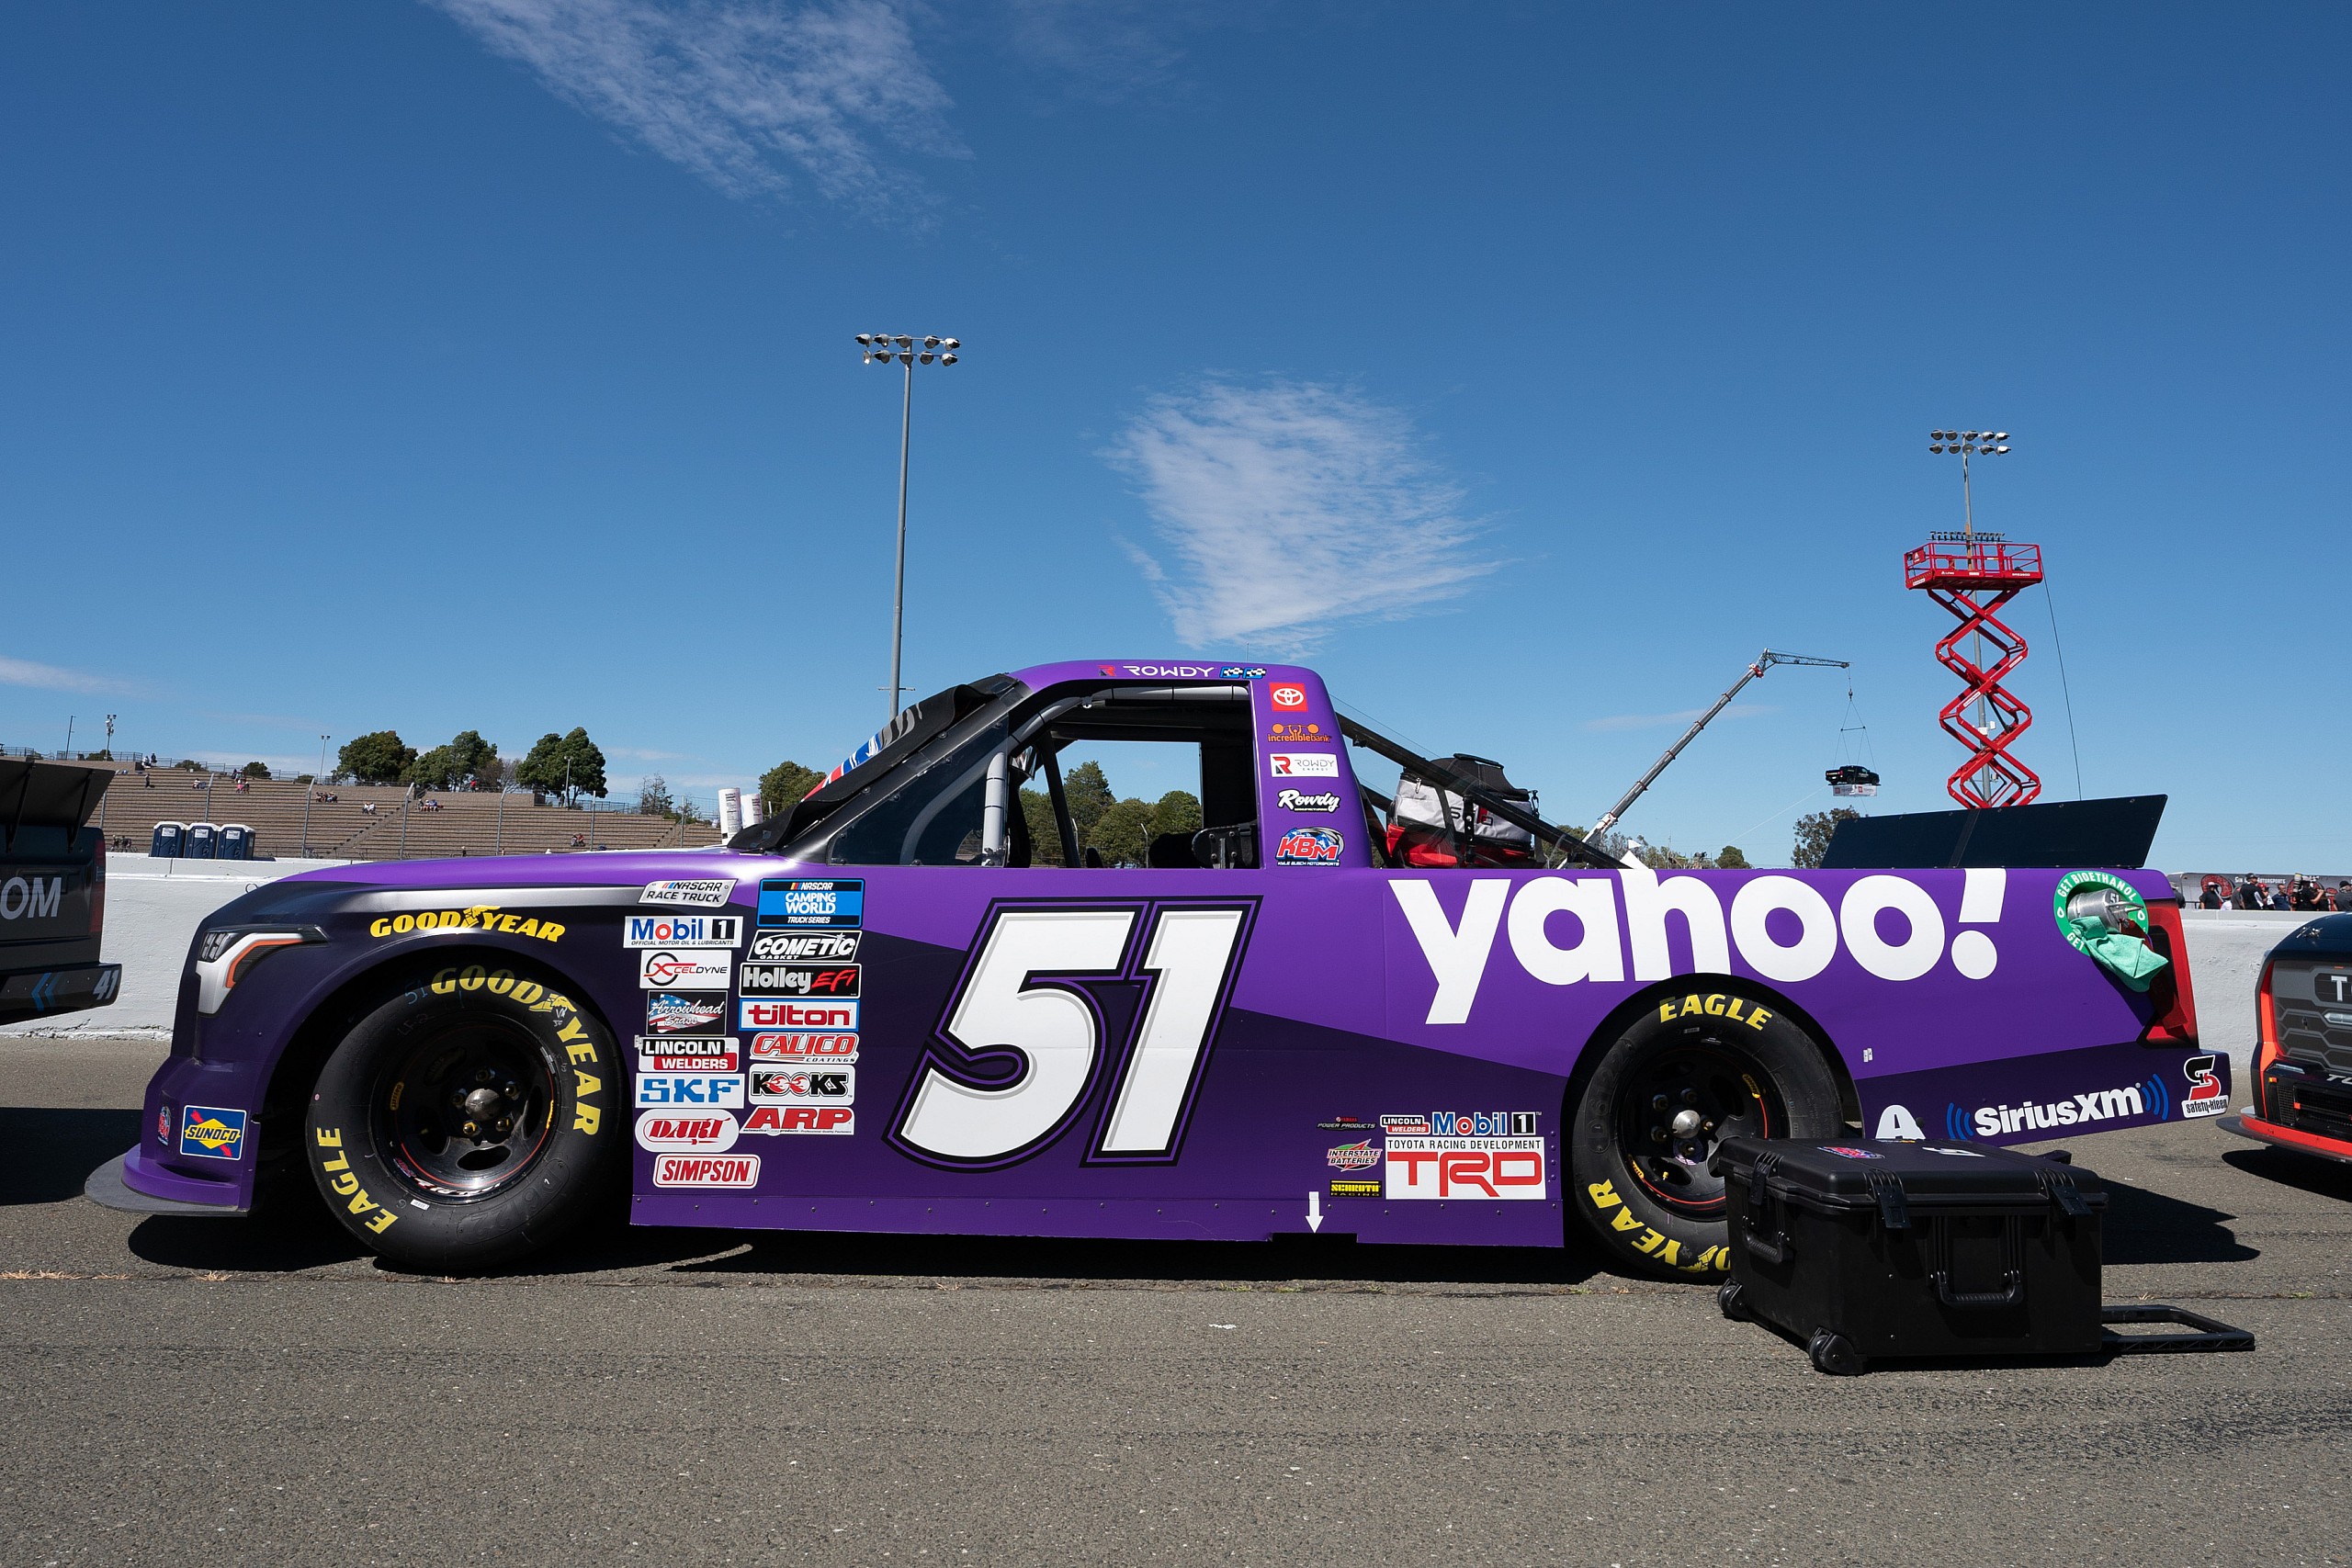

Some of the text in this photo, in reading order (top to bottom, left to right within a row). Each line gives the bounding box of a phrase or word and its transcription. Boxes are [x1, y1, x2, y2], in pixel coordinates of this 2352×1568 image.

[1123, 666, 1215, 677] ROWDY
[1278, 789, 1340, 813] Rowdy
[1276, 835, 1339, 861] KBM
[647, 891, 722, 903] RACE TRUCK
[673, 882, 723, 892] NASCAR
[800, 882, 833, 890] NASCAR
[2057, 873, 2137, 902] GET BIOETHANOL
[0, 876, 62, 919] OM
[786, 892, 836, 903] CAMPING
[786, 901, 836, 914] WORLD
[631, 919, 703, 940] Mobil
[787, 916, 831, 924] TRUCK SERIES
[754, 935, 855, 956] COMETIC
[1388, 868, 2007, 1024] yahoo!
[93, 970, 119, 1000] 41
[743, 967, 857, 994] Holley EFI
[649, 999, 725, 1015] Arrowhead
[748, 1004, 850, 1026] tilton
[1659, 993, 1773, 1032] EAGLE
[664, 1013, 698, 1026] Brass
[752, 1033, 856, 1056] CALICO
[891, 903, 1253, 1165] 51
[645, 1041, 721, 1055] LINCOLN
[662, 1058, 729, 1069] WELDERS
[640, 1078, 740, 1102] SKF
[752, 1072, 849, 1097] KOOKS
[650, 1117, 731, 1140] DART
[744, 1109, 853, 1130] ARP
[1432, 1111, 1507, 1135] Mobil
[187, 1126, 238, 1142] SUNOCO
[1388, 1140, 1541, 1149] TOYOTA RACING DEVELOPMENT
[316, 1127, 398, 1234] EAGLE
[662, 1159, 751, 1182] SIMPSON
[1387, 1151, 1543, 1198] TRD
